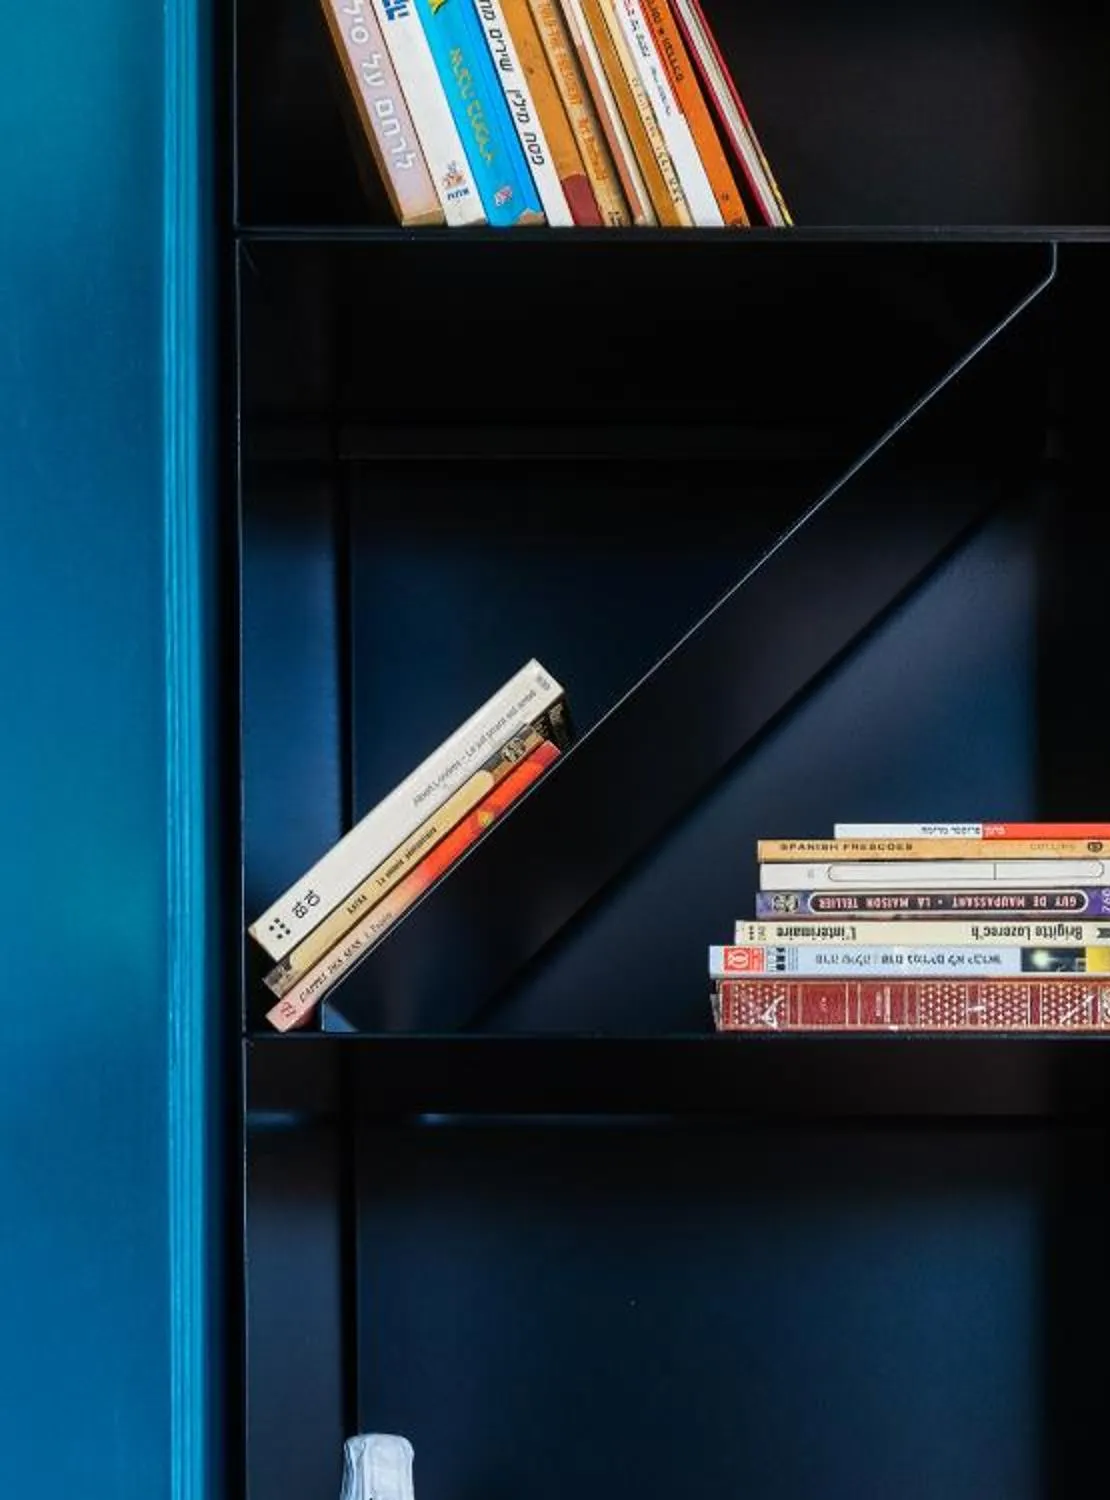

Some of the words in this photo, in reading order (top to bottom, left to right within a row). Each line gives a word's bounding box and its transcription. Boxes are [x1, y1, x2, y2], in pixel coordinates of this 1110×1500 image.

[488, 26, 514, 74] שירים
[357, 51, 389, 89] על
[372, 95, 419, 172] לרחם
[523, 129, 545, 167] פסח
[779, 843, 838, 851] SPANISH
[843, 843, 913, 851] FRESCOES
[818, 897, 859, 908] TELLIER
[866, 897, 909, 908] MAISON
[918, 897, 936, 908] LA
[951, 895, 1026, 908] MAUPASSANT
[1032, 895, 1048, 907] DE
[1056, 895, 1077, 907] GUY
[1034, 926, 1083, 941] Brigitte
[948, 954, 964, 966] לא
